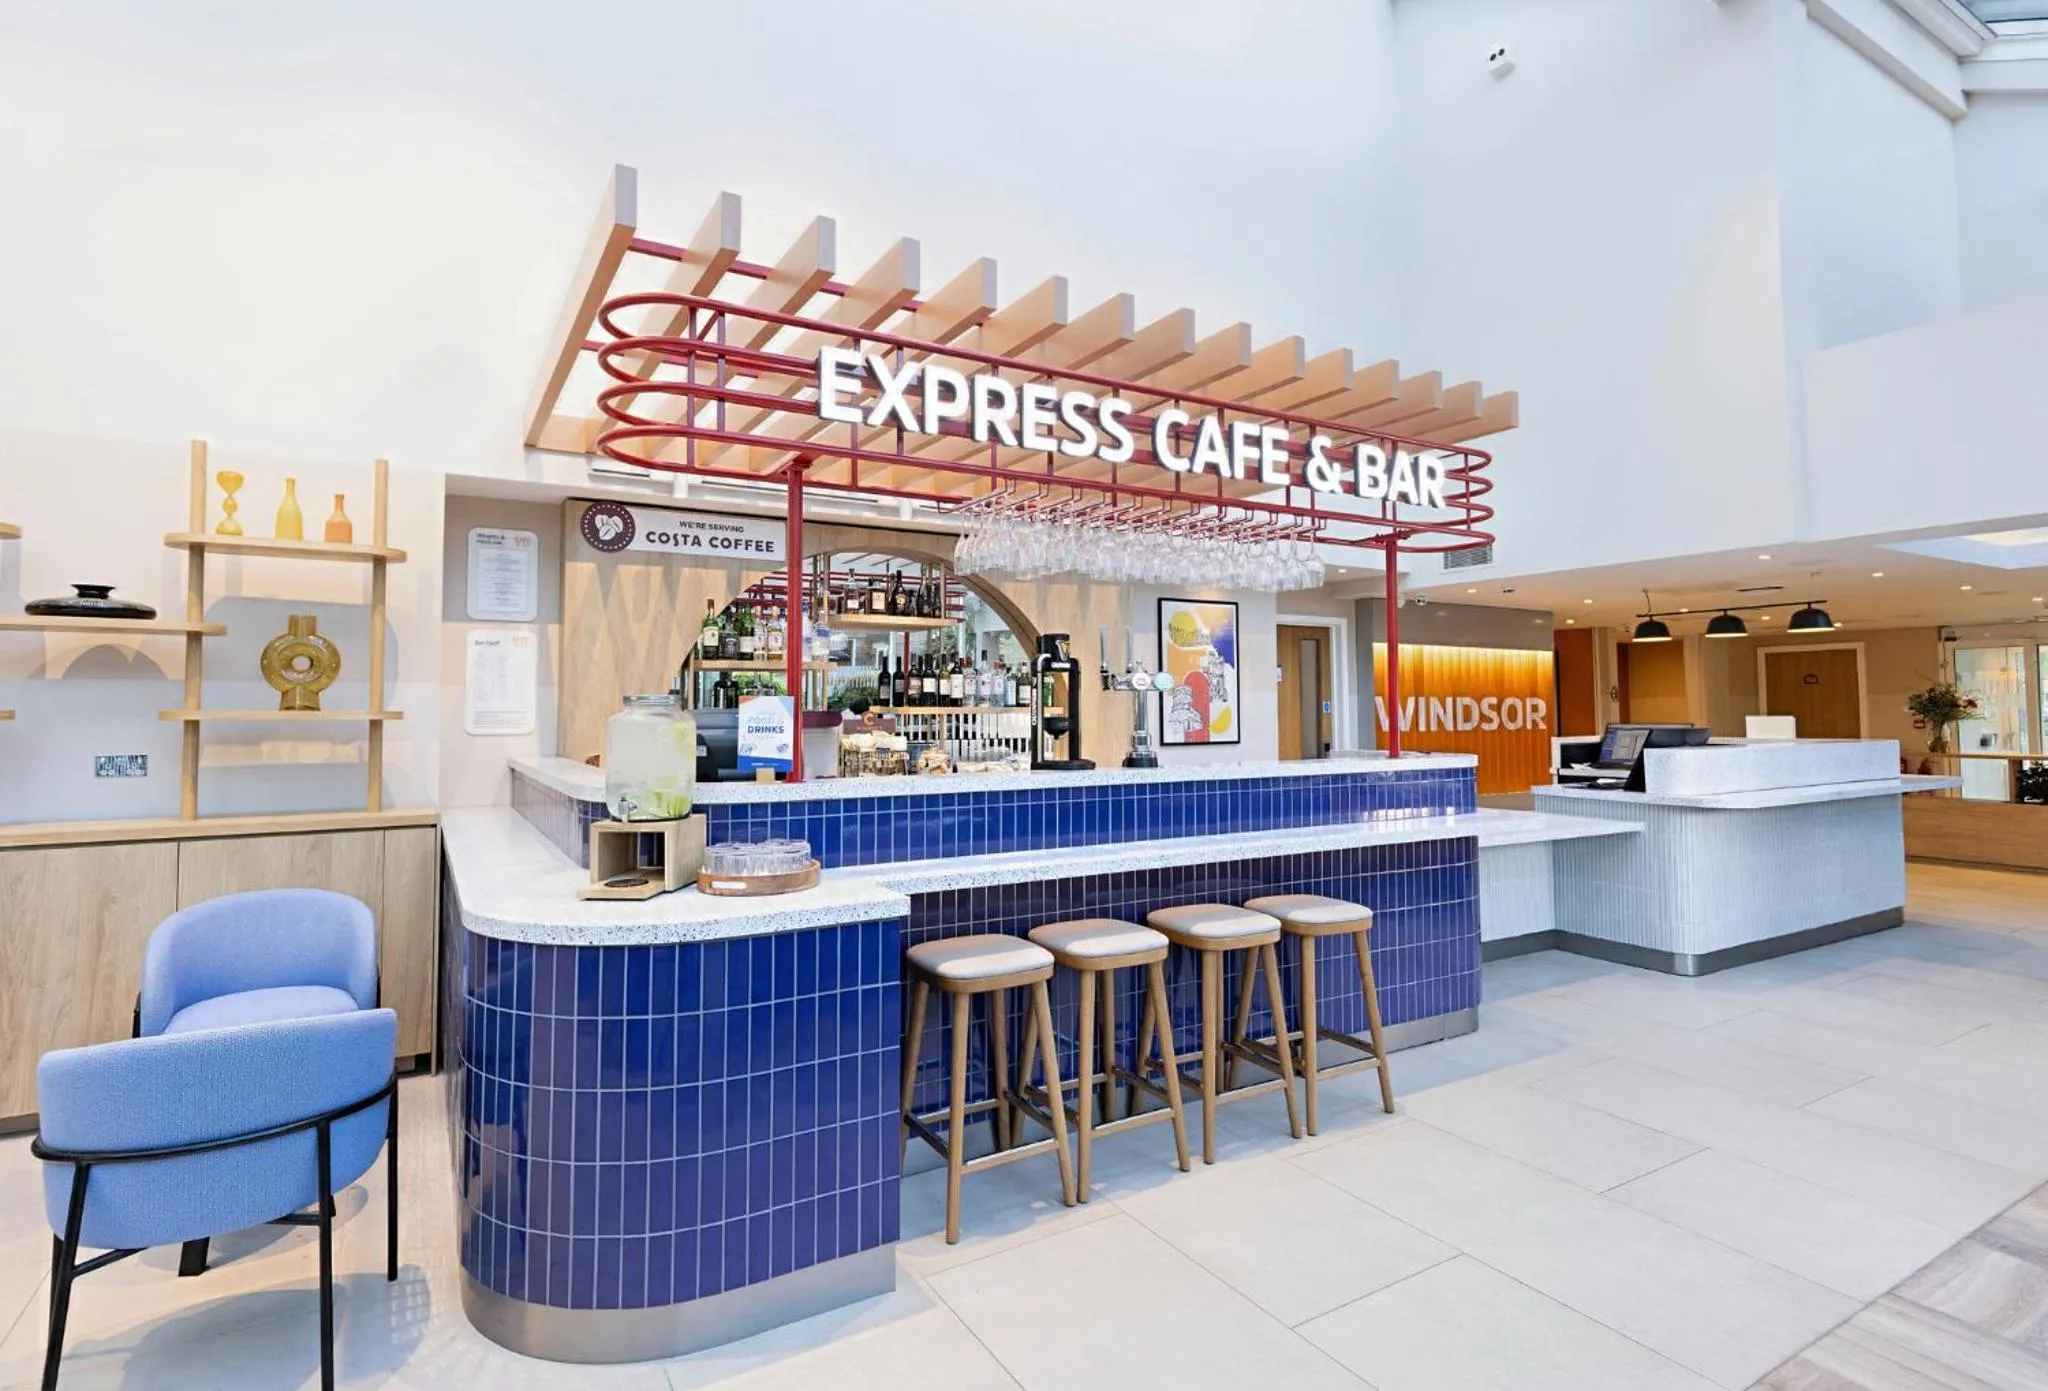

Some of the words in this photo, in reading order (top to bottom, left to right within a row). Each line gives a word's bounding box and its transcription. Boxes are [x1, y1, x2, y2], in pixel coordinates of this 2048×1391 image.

[819, 345, 1135, 463] EXPRESS
[1152, 408, 1290, 486] CAFE
[1303, 435, 1344, 494] &
[1354, 443, 1446, 509] BAR
[679, 520, 706, 530] WE'RE
[708, 523, 745, 533] SERVING
[646, 531, 702, 547] COSTA
[709, 536, 775, 553] COFFEE
[1374, 696, 1547, 732] WINDSOR
[747, 725, 785, 734] DRINKS
